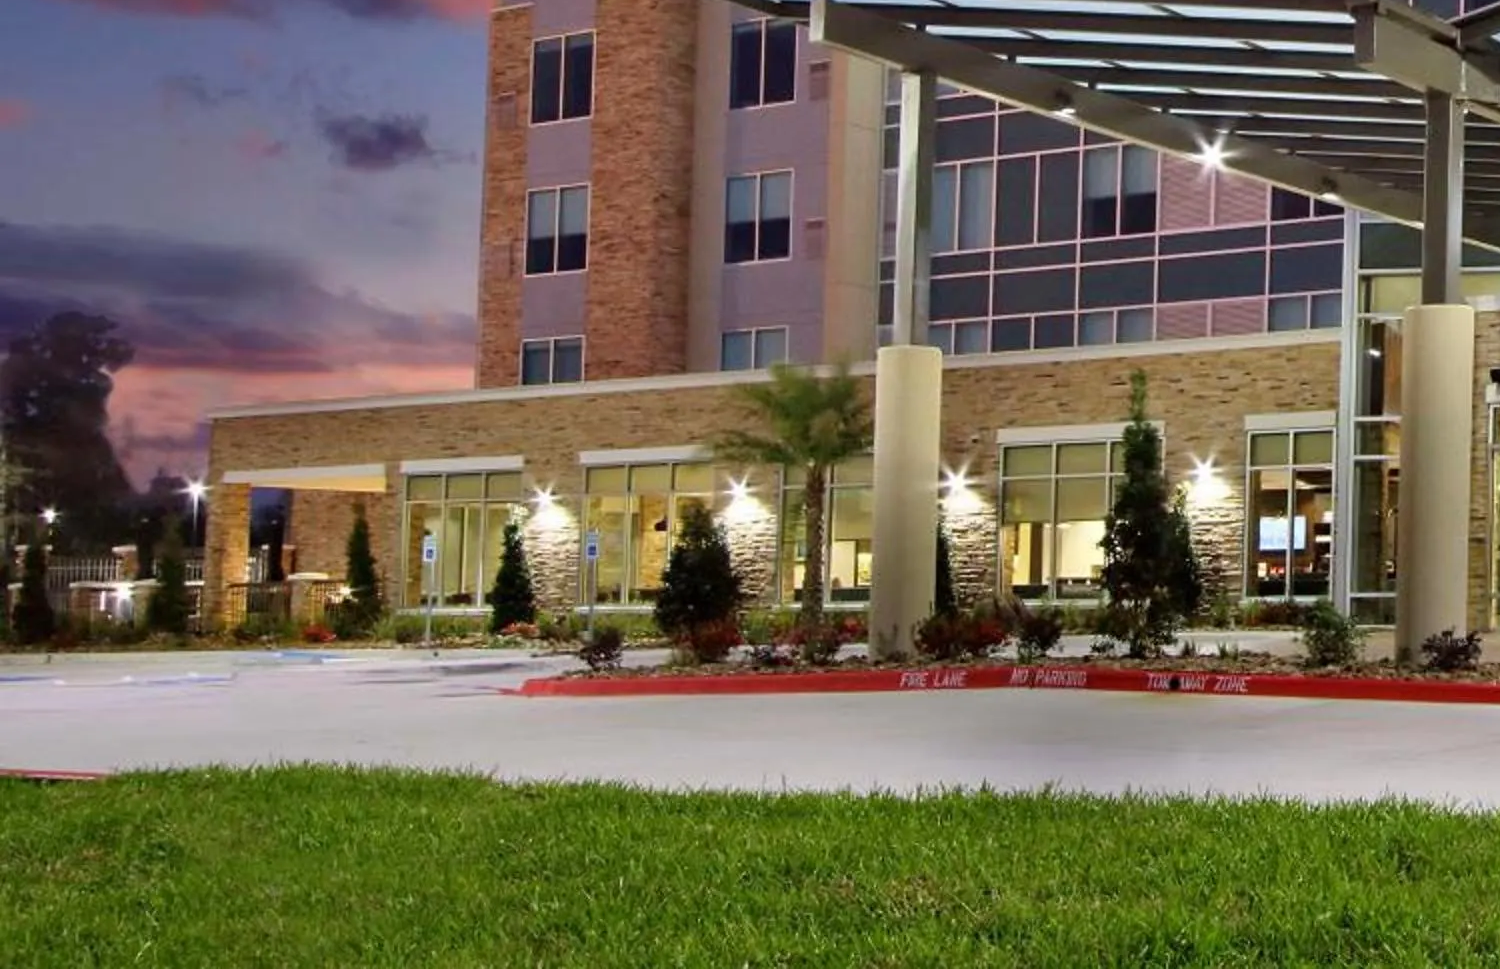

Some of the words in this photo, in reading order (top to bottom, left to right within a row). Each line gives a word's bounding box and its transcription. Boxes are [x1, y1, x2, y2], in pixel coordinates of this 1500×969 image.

[900, 672, 928, 687] FIRE
[933, 672, 967, 687] LANE
[1010, 668, 1030, 686] NO
[1034, 670, 1086, 687] PARKING
[1213, 676, 1252, 692] ZONE
